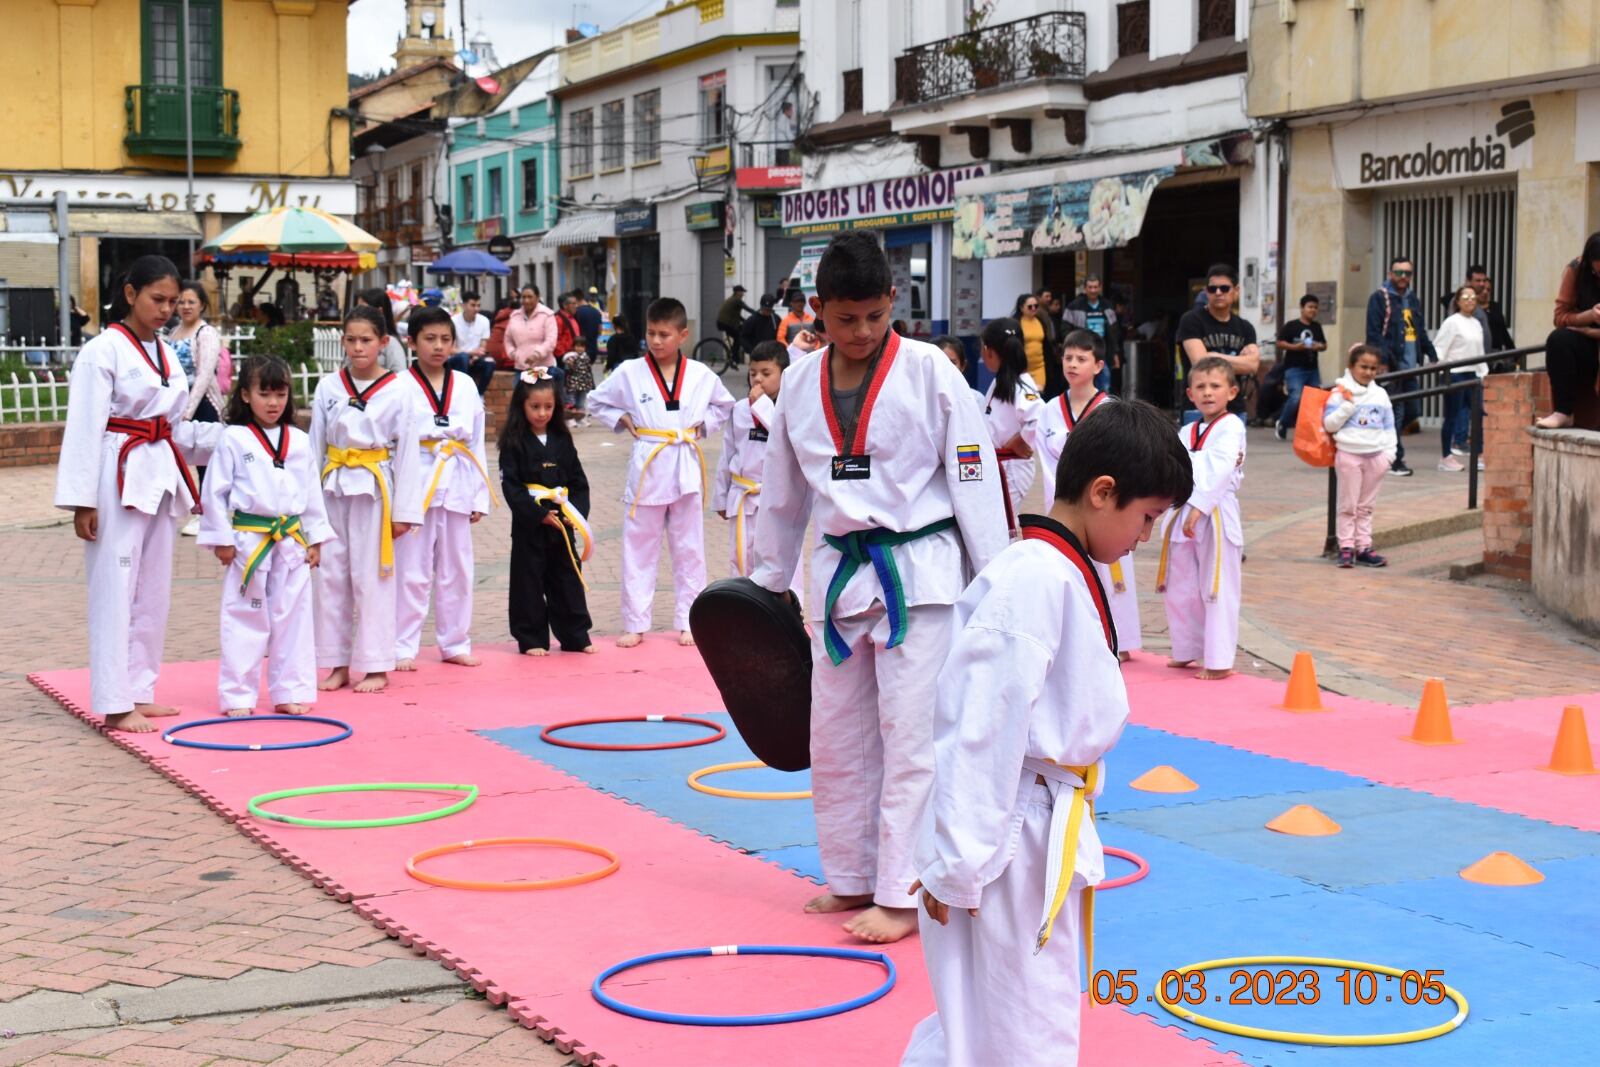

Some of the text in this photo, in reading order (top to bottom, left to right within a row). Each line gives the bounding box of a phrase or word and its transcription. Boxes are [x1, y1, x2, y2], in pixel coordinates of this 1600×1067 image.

[1360, 134, 1506, 184] Bancolombia
[784, 187, 850, 223] DROGAS
[857, 182, 876, 214] LA
[853, 217, 898, 229] DROGUERIA
[912, 211, 938, 222] SUPER
